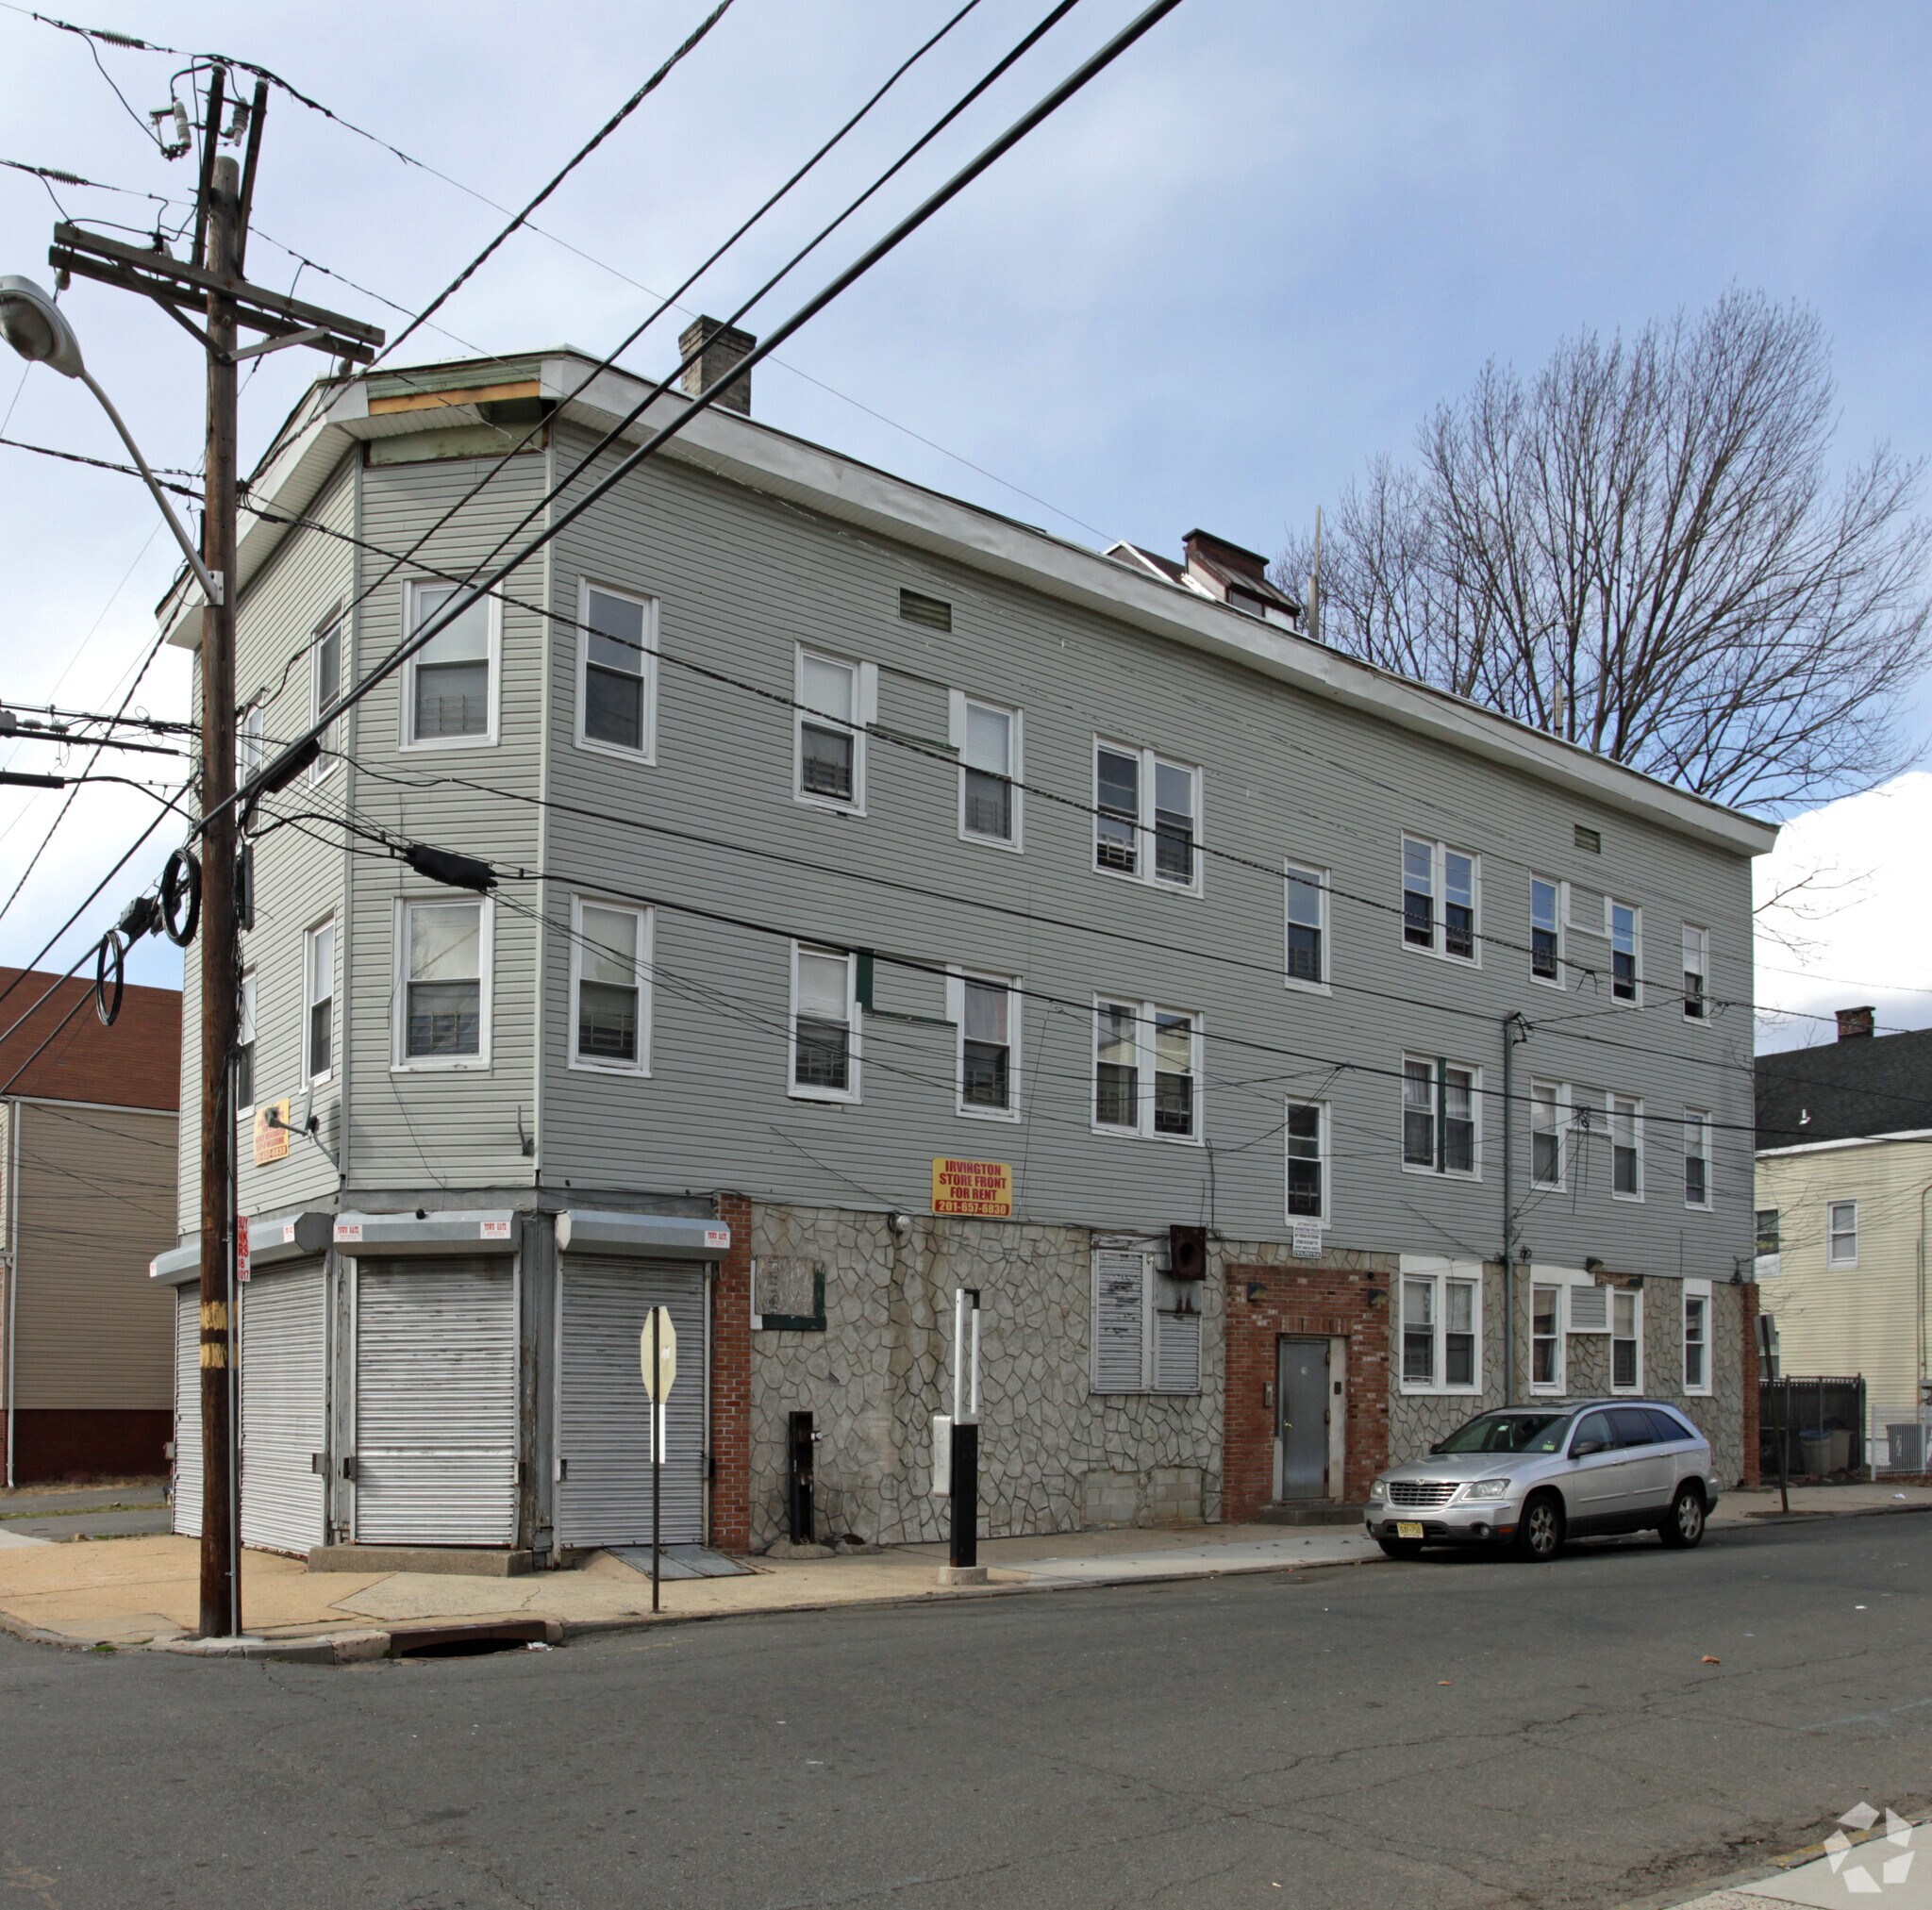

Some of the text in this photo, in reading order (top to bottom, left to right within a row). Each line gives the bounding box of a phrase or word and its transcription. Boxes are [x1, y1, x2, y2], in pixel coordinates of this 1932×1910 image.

[945, 1160, 1001, 1176] IRVINGTON
[940, 1172, 1007, 1189] STORE FRONT
[950, 1187, 997, 1201] FOR RENT
[939, 1201, 1007, 1215] 201-657-6830
[239, 1230, 248, 1244] NK
[239, 1244, 248, 1257] RS
